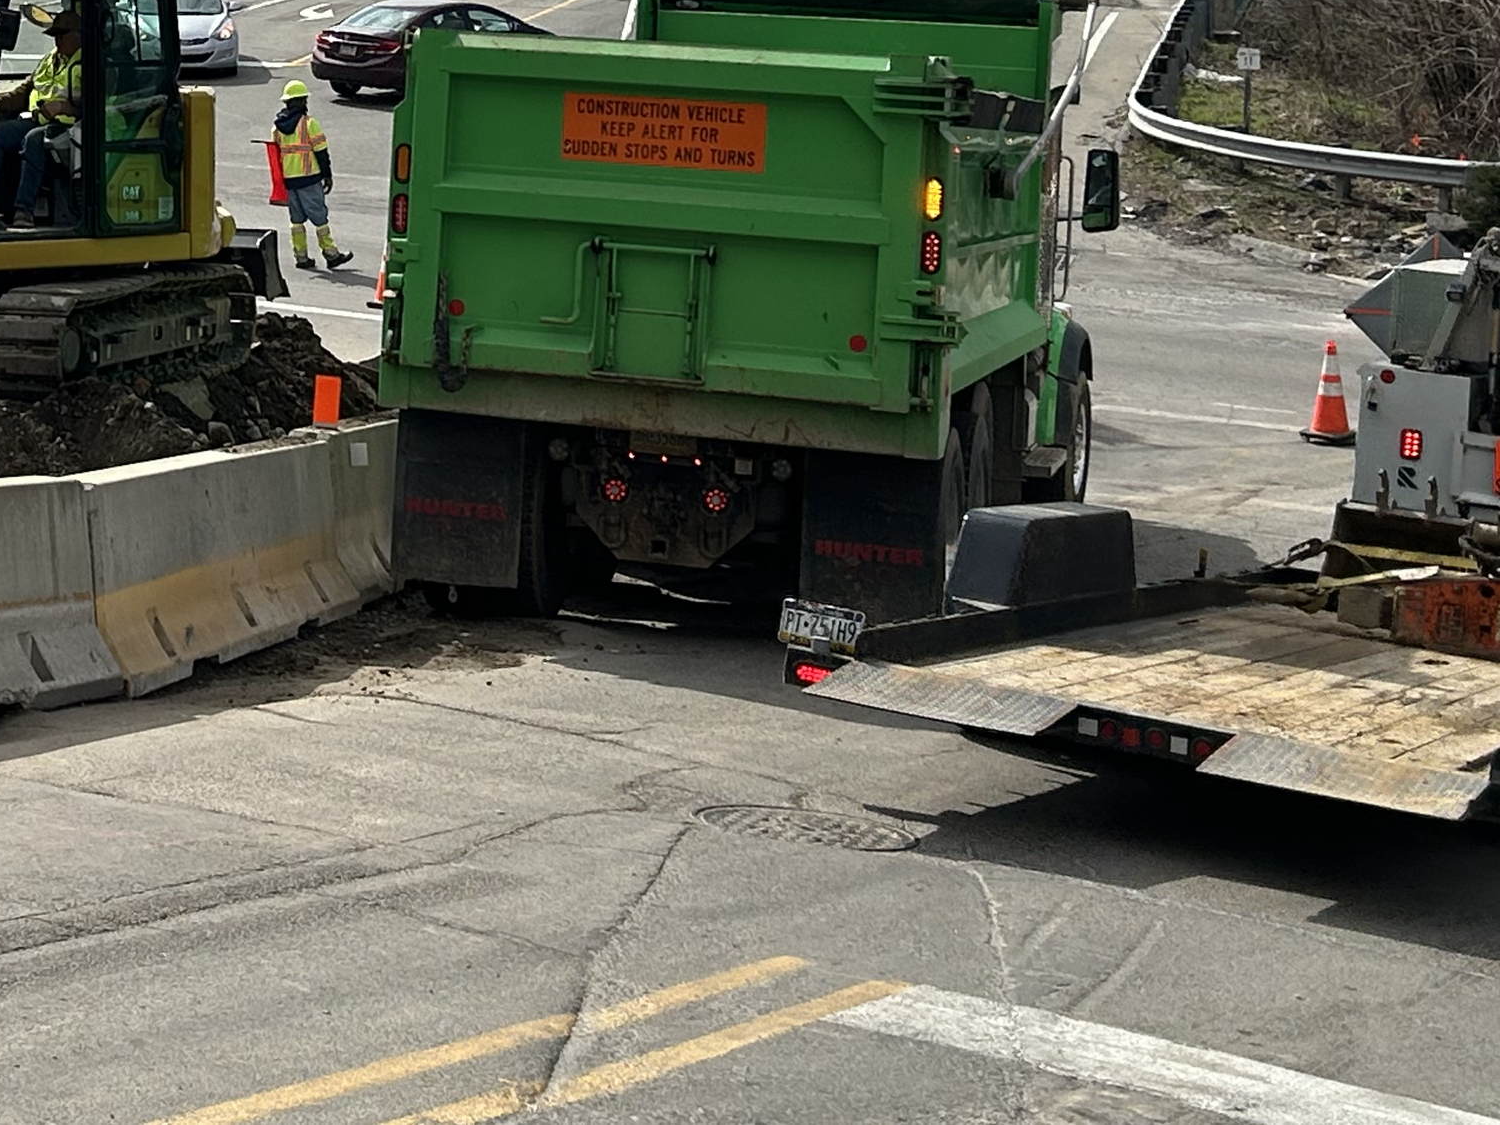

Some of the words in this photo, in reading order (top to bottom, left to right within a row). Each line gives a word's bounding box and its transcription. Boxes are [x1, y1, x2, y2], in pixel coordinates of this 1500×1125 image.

[577, 98, 680, 120] CONSTRUCTION
[687, 105, 746, 124] VEHICLE
[601, 120, 636, 138] KEEP
[642, 124, 685, 141] ALERT
[691, 126, 719, 144] FOR
[563, 139, 618, 157] SUDDEN
[625, 143, 668, 161] STOPS
[674, 147, 703, 164] AND
[710, 149, 756, 167] TURNS
[814, 539, 923, 566] HUNTER
